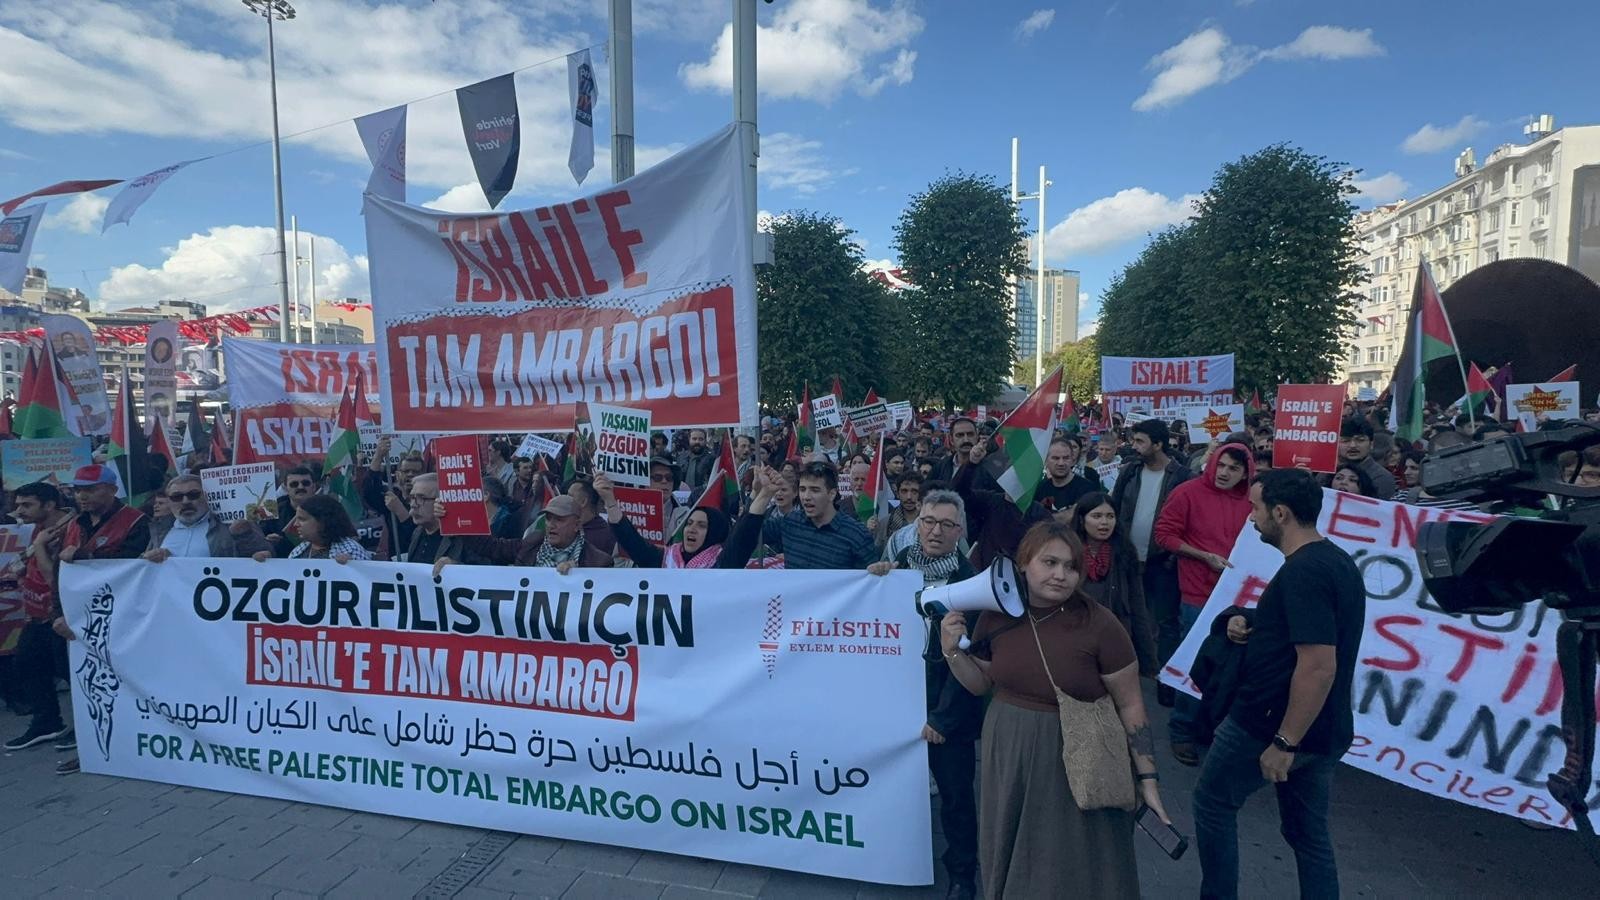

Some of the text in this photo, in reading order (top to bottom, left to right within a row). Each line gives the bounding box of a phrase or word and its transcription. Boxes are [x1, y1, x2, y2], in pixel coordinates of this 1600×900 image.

[438, 190, 648, 303] İSRAİL'E
[399, 307, 722, 409] TAM AMBARGO!
[279, 350, 380, 394] İSRAİ
[1131, 359, 1209, 386] İSRAİL'E
[1281, 399, 1333, 413] İSRAİL'E
[601, 411, 648, 433] YAŞASIN
[1291, 415, 1317, 427] TAM
[246, 417, 336, 456] ASKER
[599, 429, 648, 458] ÖZGÜR
[1274, 429, 1337, 443] AMBARGO
[439, 453, 473, 470] İSRAİL'E
[597, 451, 649, 477] FİLİSTİN
[446, 472, 466, 486] TAM
[207, 489, 236, 502] SRAİL'E
[439, 488, 483, 503] AMBARGO
[617, 499, 656, 515] İSRAİL'E
[193, 566, 694, 657] ÖZGÜR FİLİSTİN İÇİN
[791, 617, 902, 640] FİLİSTİN
[789, 641, 902, 656] EYLEM KOMİTESİ
[253, 627, 634, 717] İSRAİL'E TAM AMBARGO
[135, 696, 870, 796] من أجل فلسطين حرة حظر شامل على الكيان الصهيوني
[137, 733, 865, 849] FOR A FREE PALESTINE TOTAL EMBARGO ON ISRAEL
